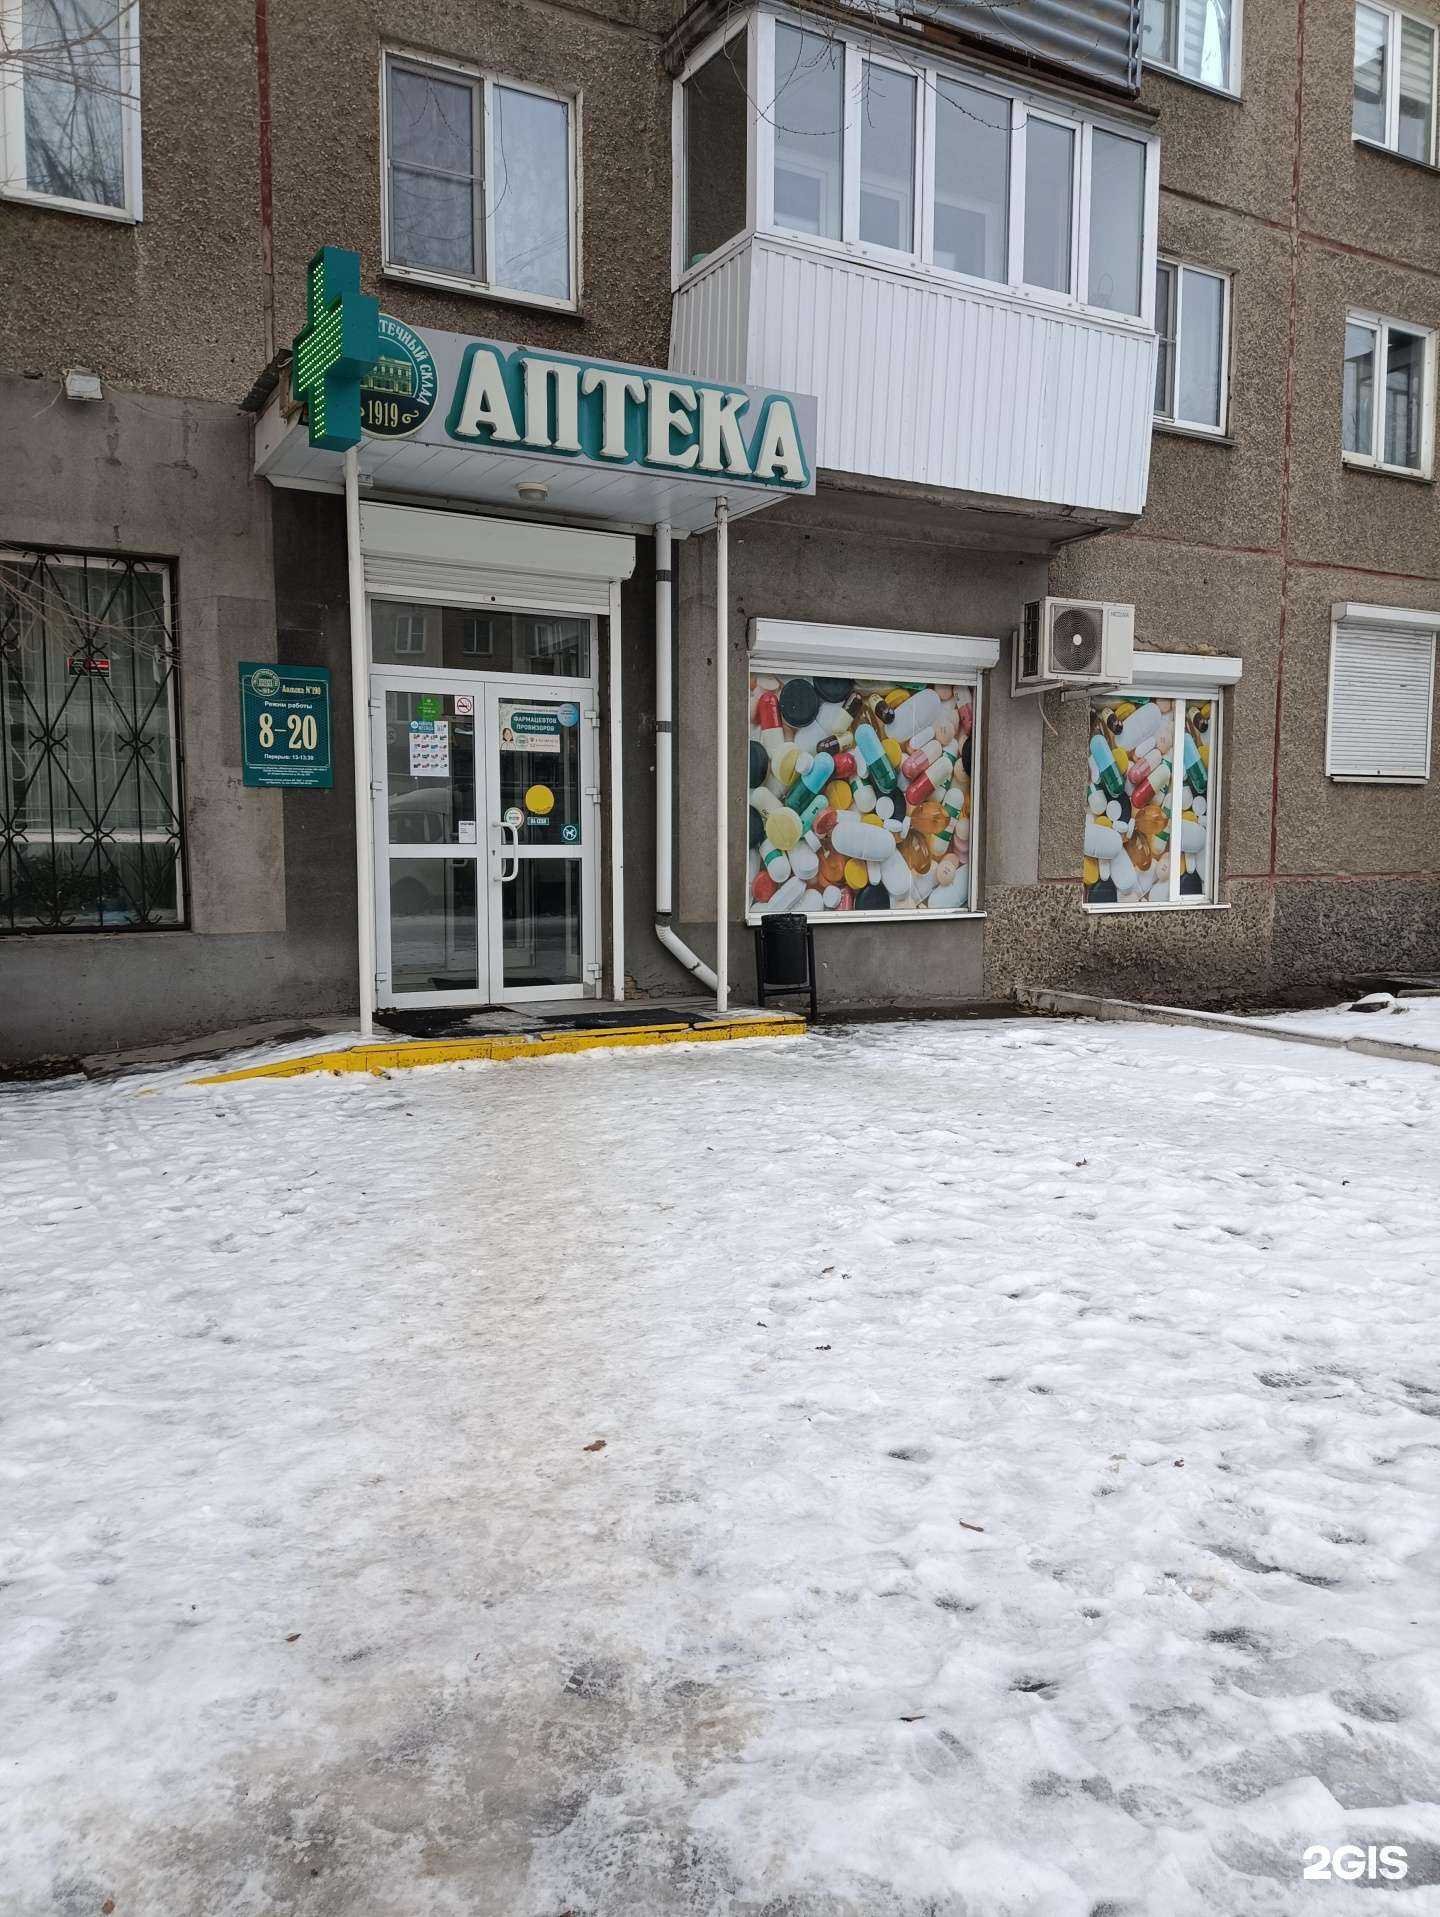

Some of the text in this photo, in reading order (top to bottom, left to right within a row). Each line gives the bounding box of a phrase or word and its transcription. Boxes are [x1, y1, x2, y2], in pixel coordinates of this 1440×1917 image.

[378, 319, 434, 406] ТЕЧНЫЙ СКЛАД
[368, 400, 398, 428] 1919
[455, 349, 806, 483] АПТЕКА
[516, 724, 555, 732] ПРОВИЗОРОВ
